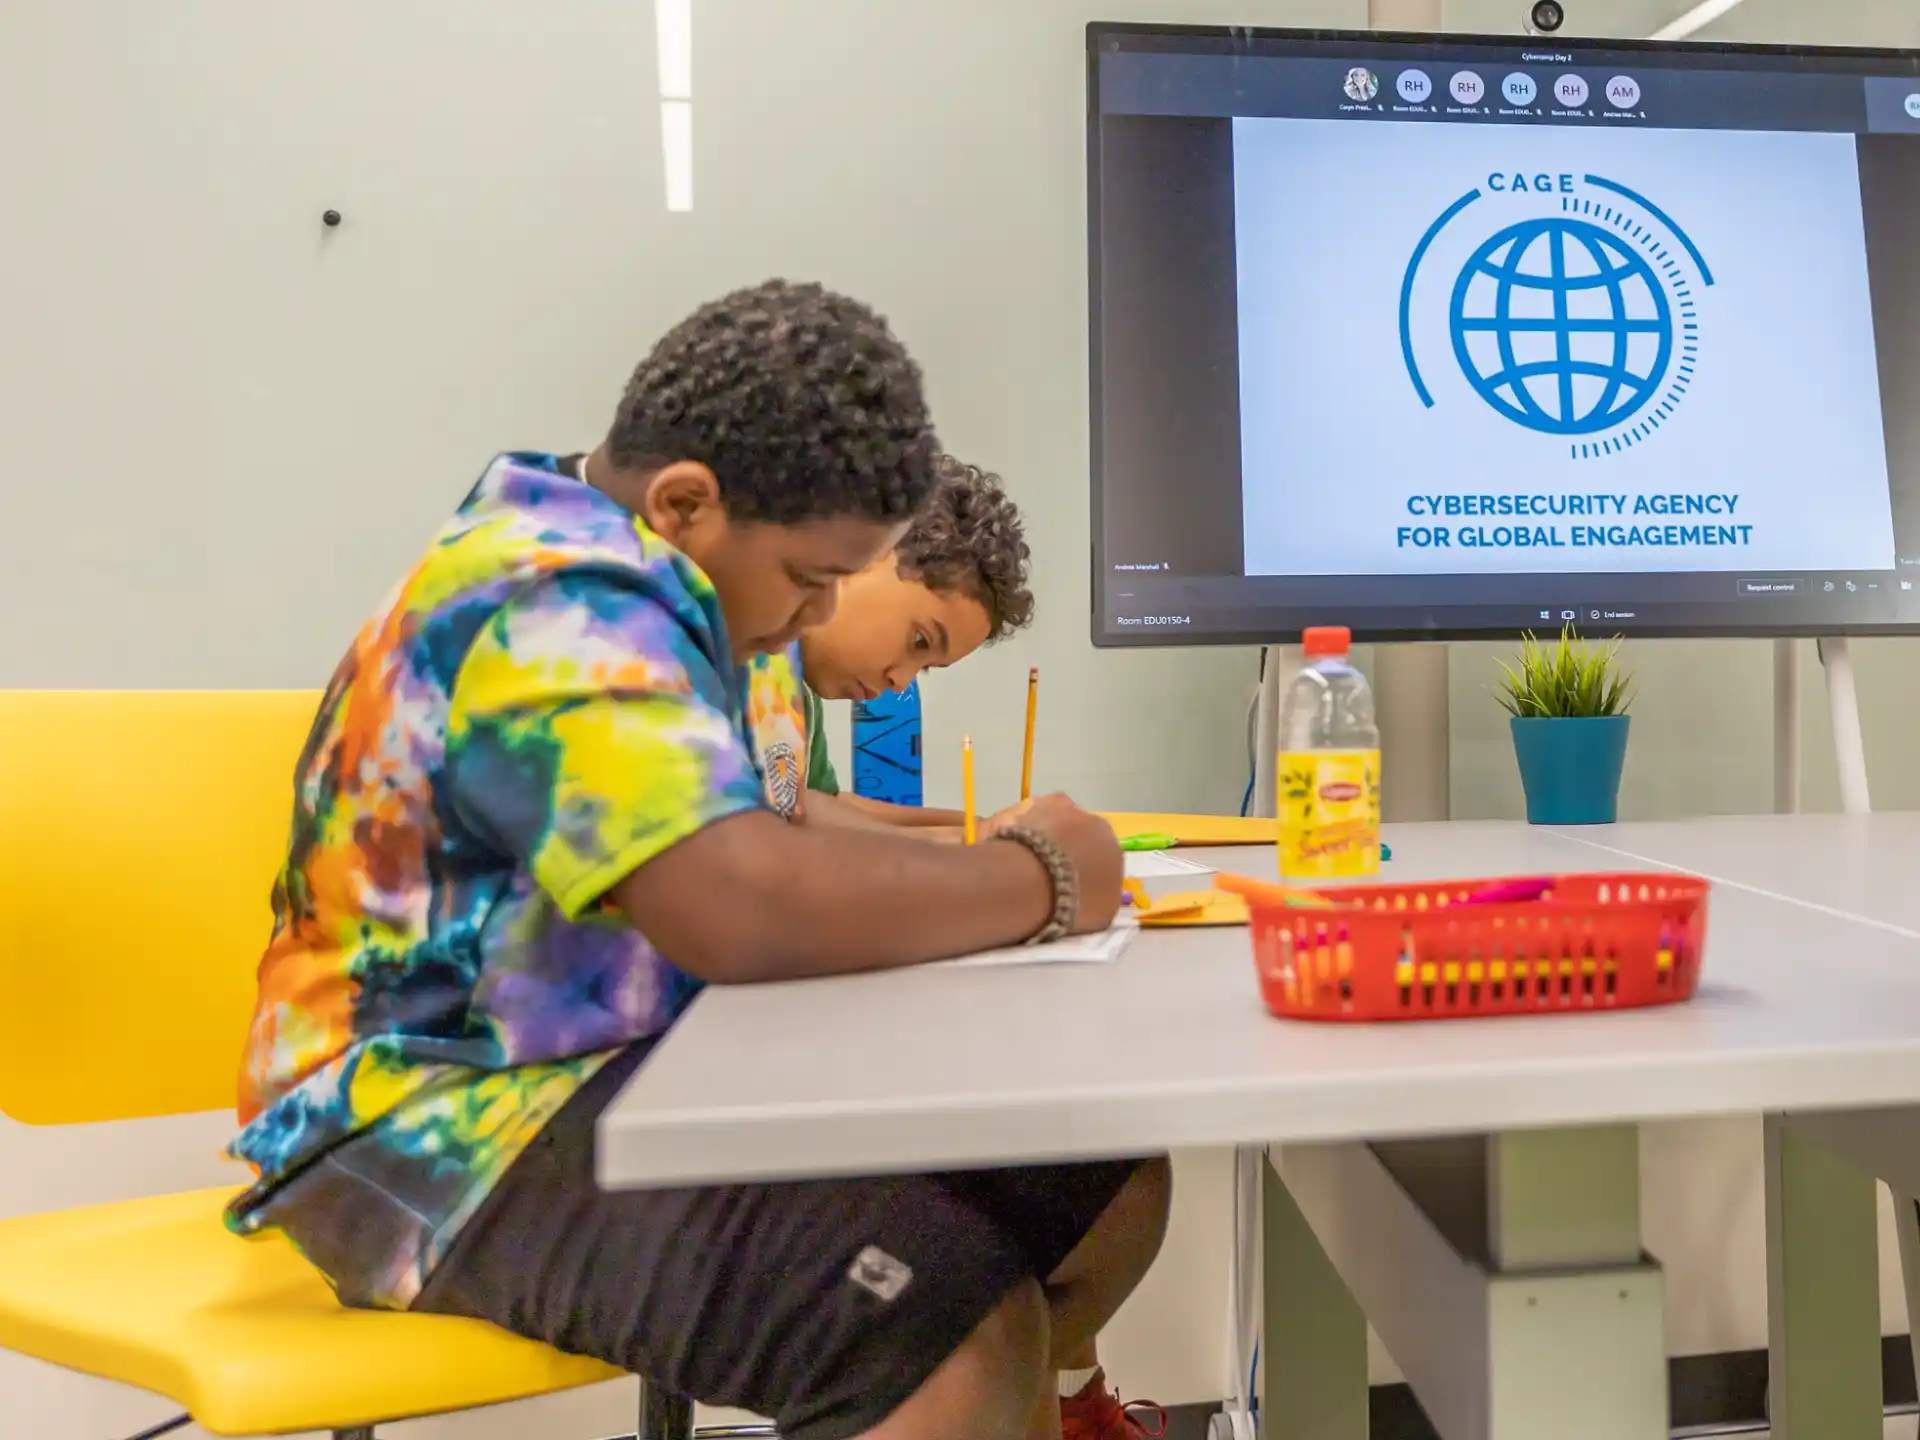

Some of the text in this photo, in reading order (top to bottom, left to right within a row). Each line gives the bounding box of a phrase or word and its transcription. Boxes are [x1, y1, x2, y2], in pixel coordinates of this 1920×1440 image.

[1555, 54, 1567, 62] Day
[1567, 54, 1572, 62] 2
[1405, 81, 1424, 91] RH
[1457, 83, 1476, 92] RH
[1510, 84, 1529, 95] RH
[1562, 86, 1581, 96] RH
[1612, 87, 1634, 97] AM
[1487, 172, 1574, 193] CAGE
[1407, 494, 1738, 515] CYBERSECURITY AGENCY
[1397, 525, 1753, 547] FOR GLOBAL ENGAGEMENT
[1117, 616, 1142, 625] Room
